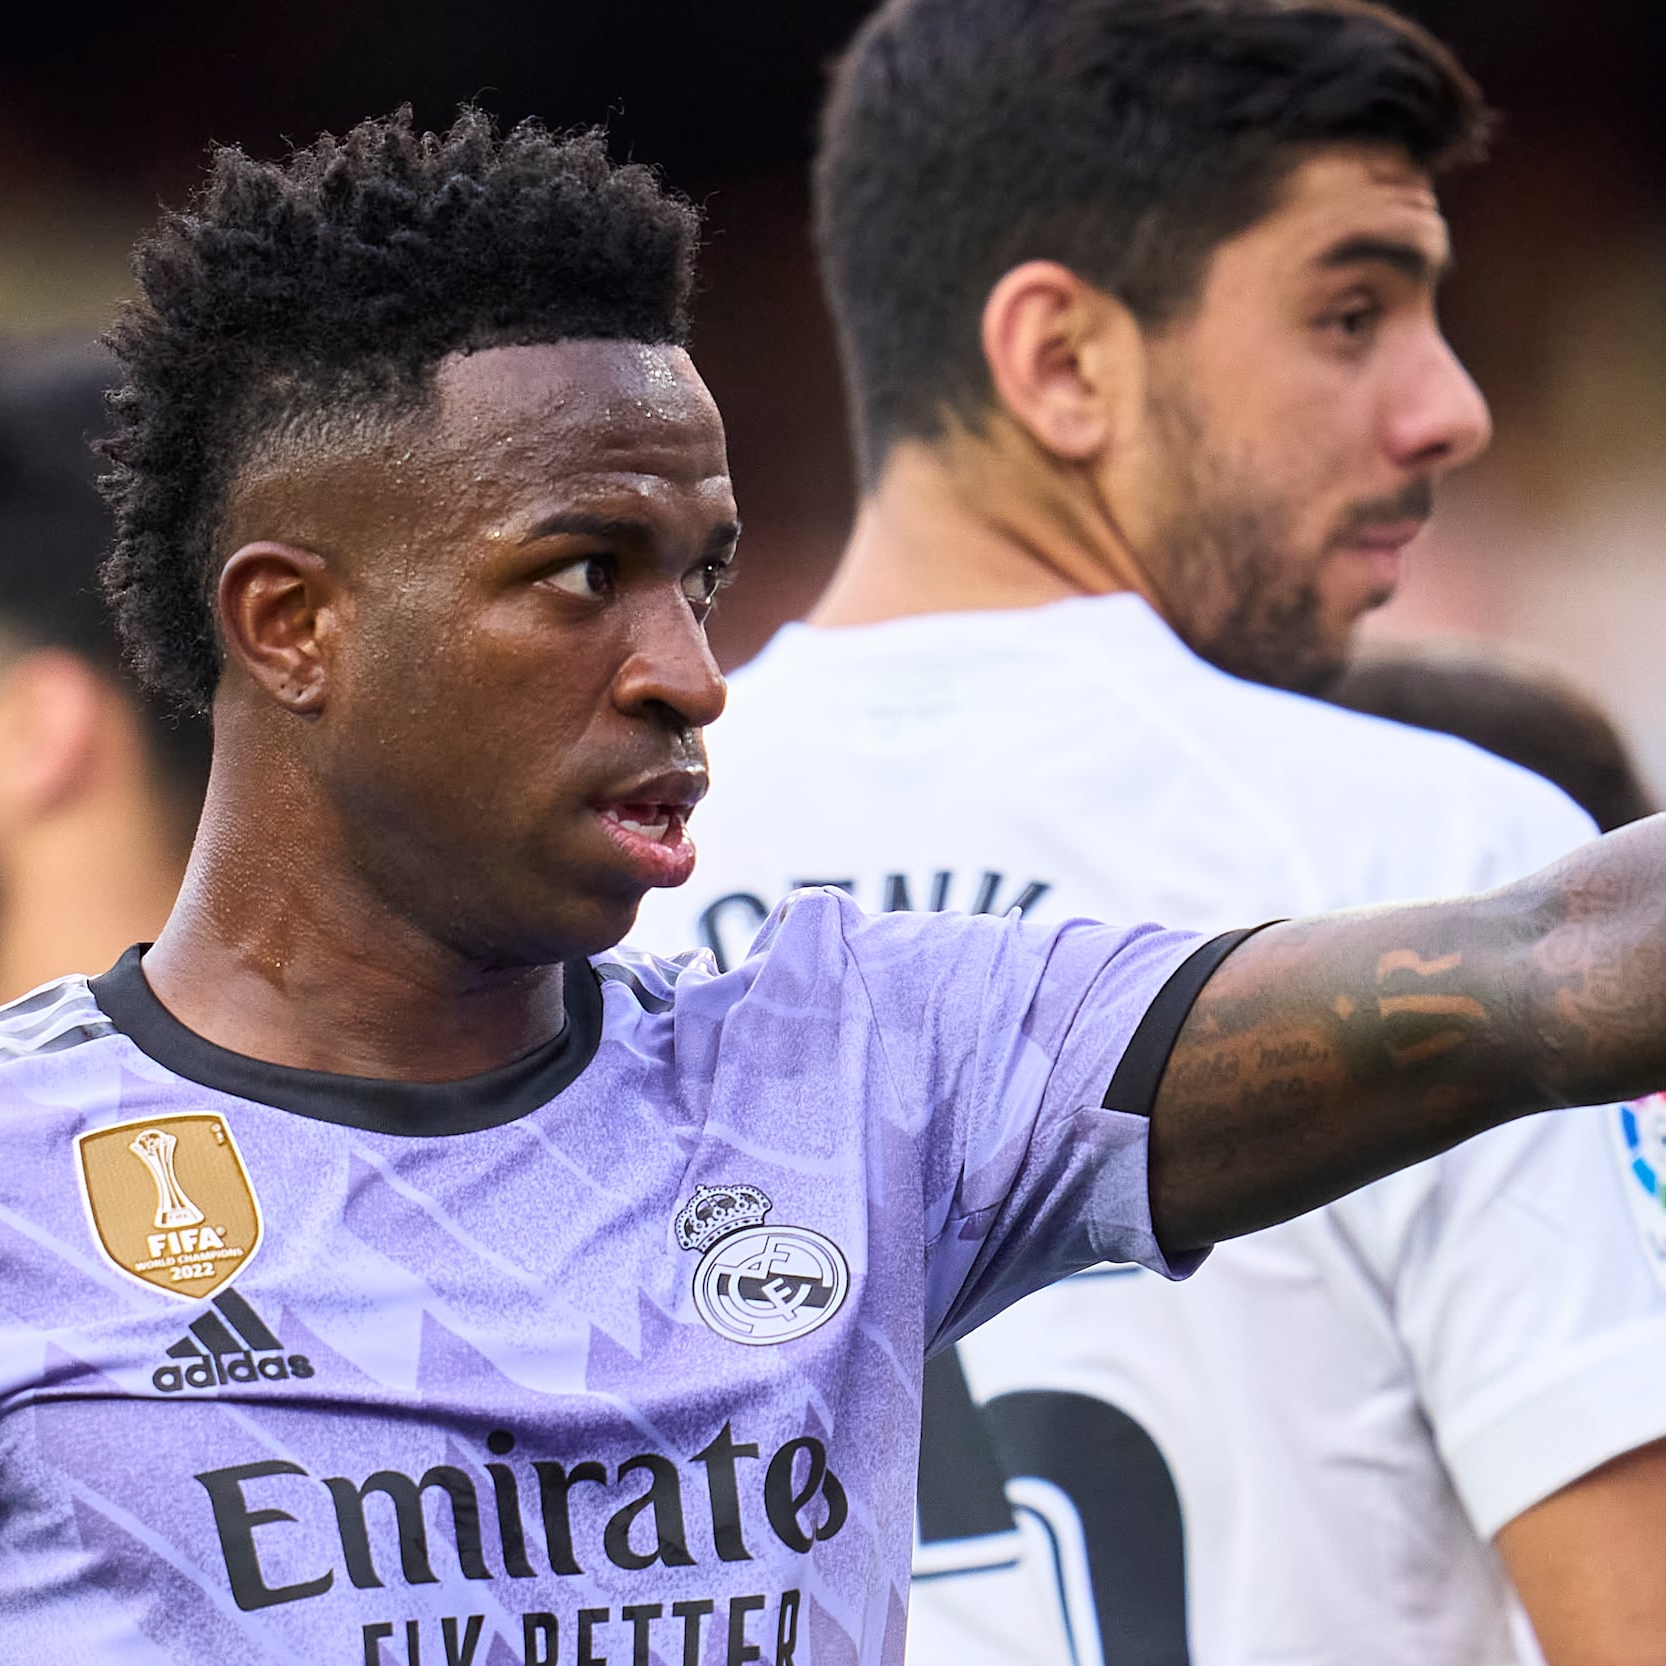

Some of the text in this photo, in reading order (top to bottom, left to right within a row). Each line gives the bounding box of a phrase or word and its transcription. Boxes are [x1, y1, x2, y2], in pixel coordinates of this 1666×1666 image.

[146, 1226, 225, 1259] FIFA
[135, 1247, 244, 1272] WORLD CHAMPIONS
[170, 1261, 216, 1282] 2022
[152, 1351, 315, 1393] adidas
